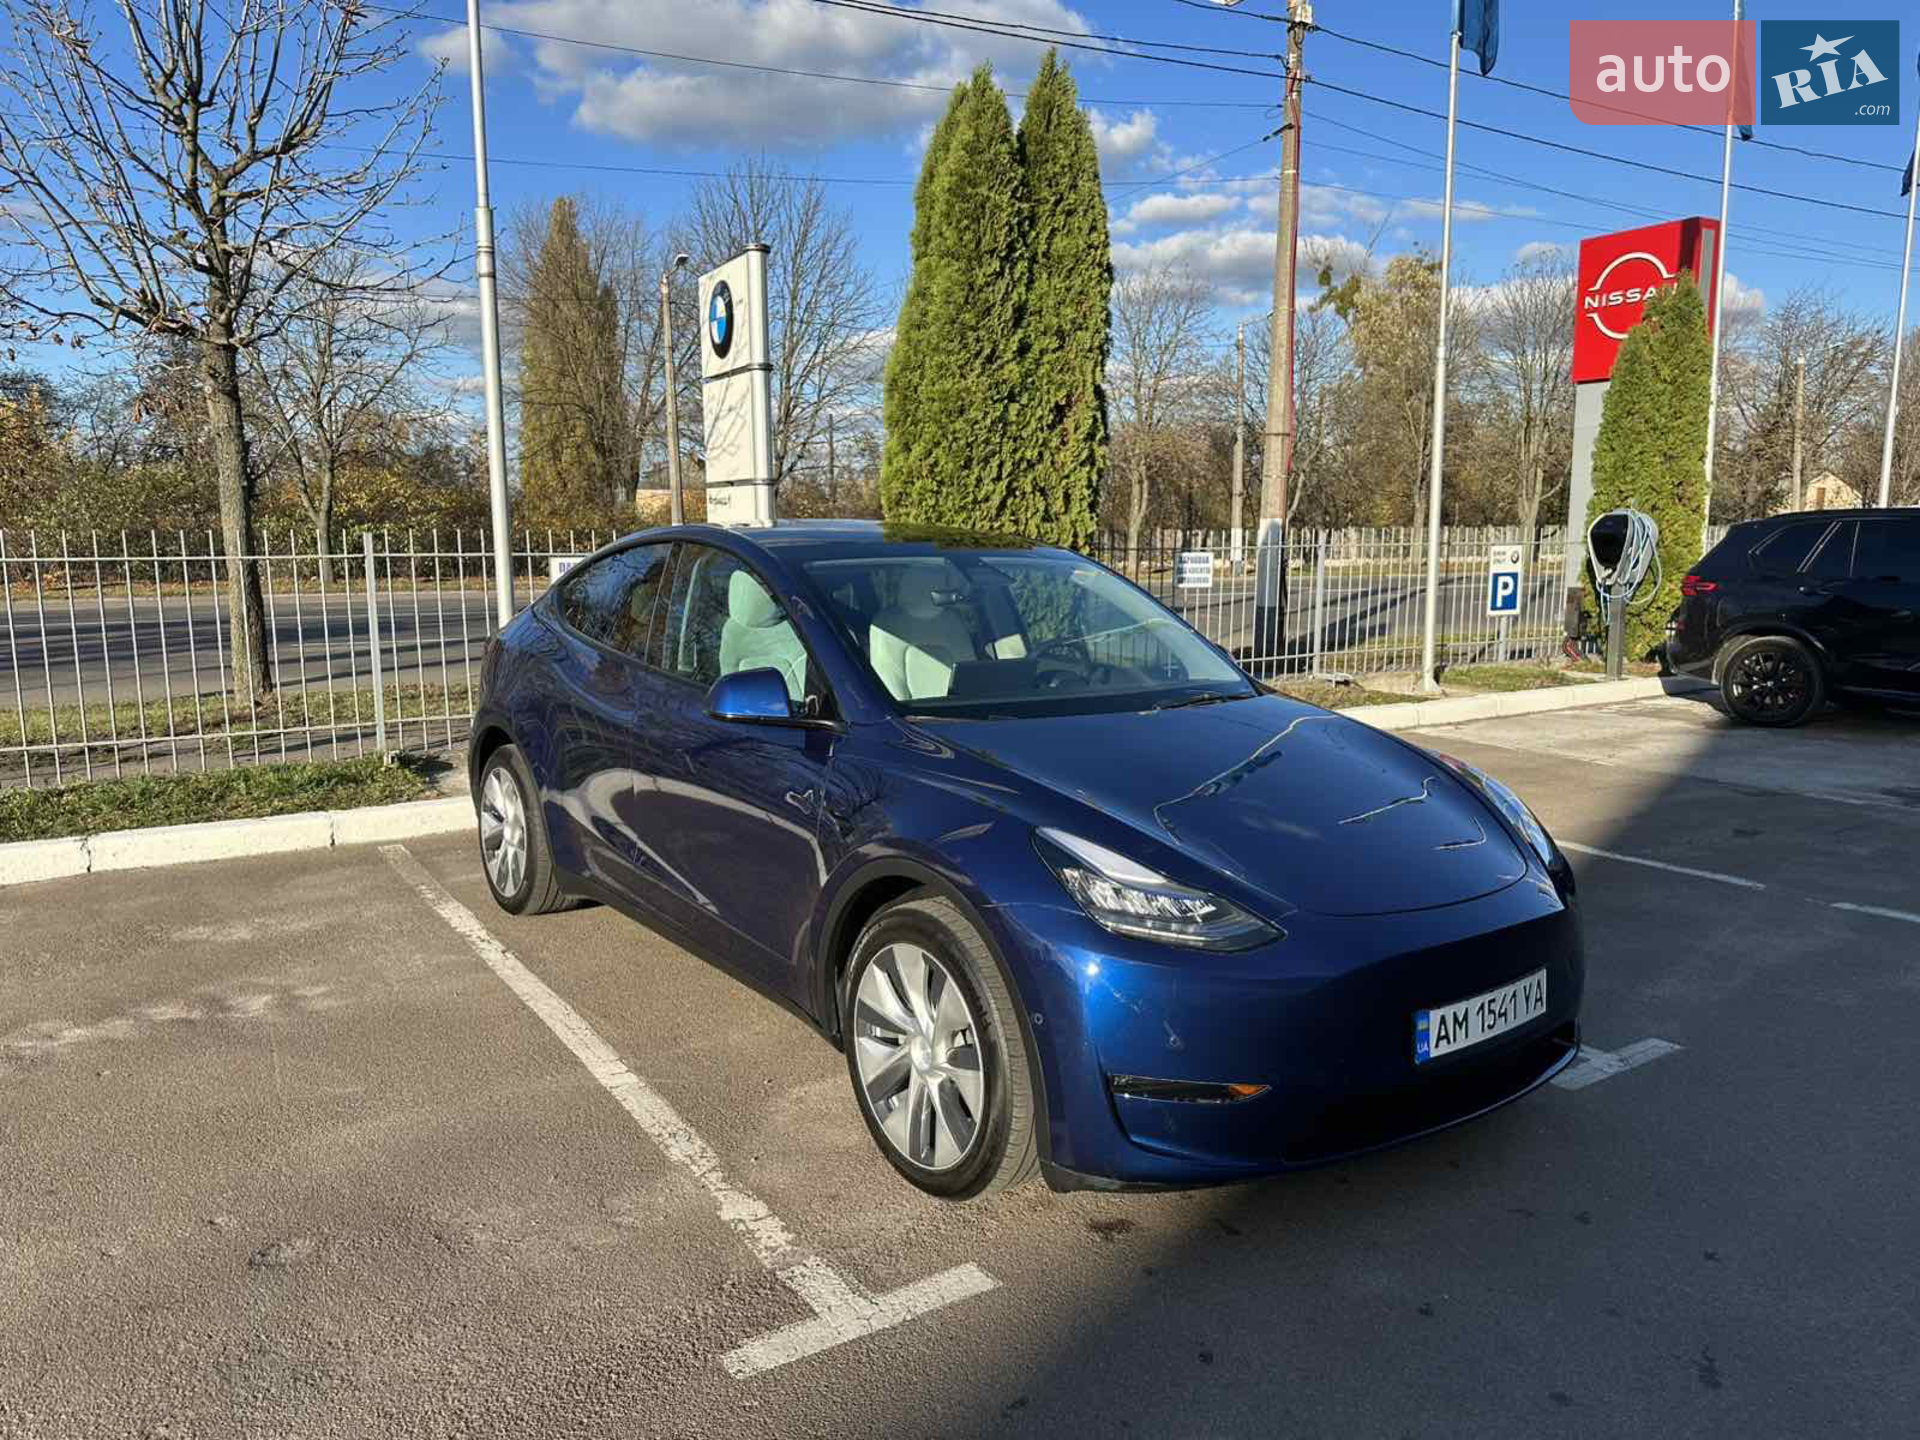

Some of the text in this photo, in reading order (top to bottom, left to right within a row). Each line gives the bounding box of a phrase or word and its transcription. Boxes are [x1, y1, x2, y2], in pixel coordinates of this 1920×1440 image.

[1584, 282, 1678, 309] NISSA
[1496, 575, 1514, 607] P
[1434, 979, 1544, 1049] AM 1541 YA
